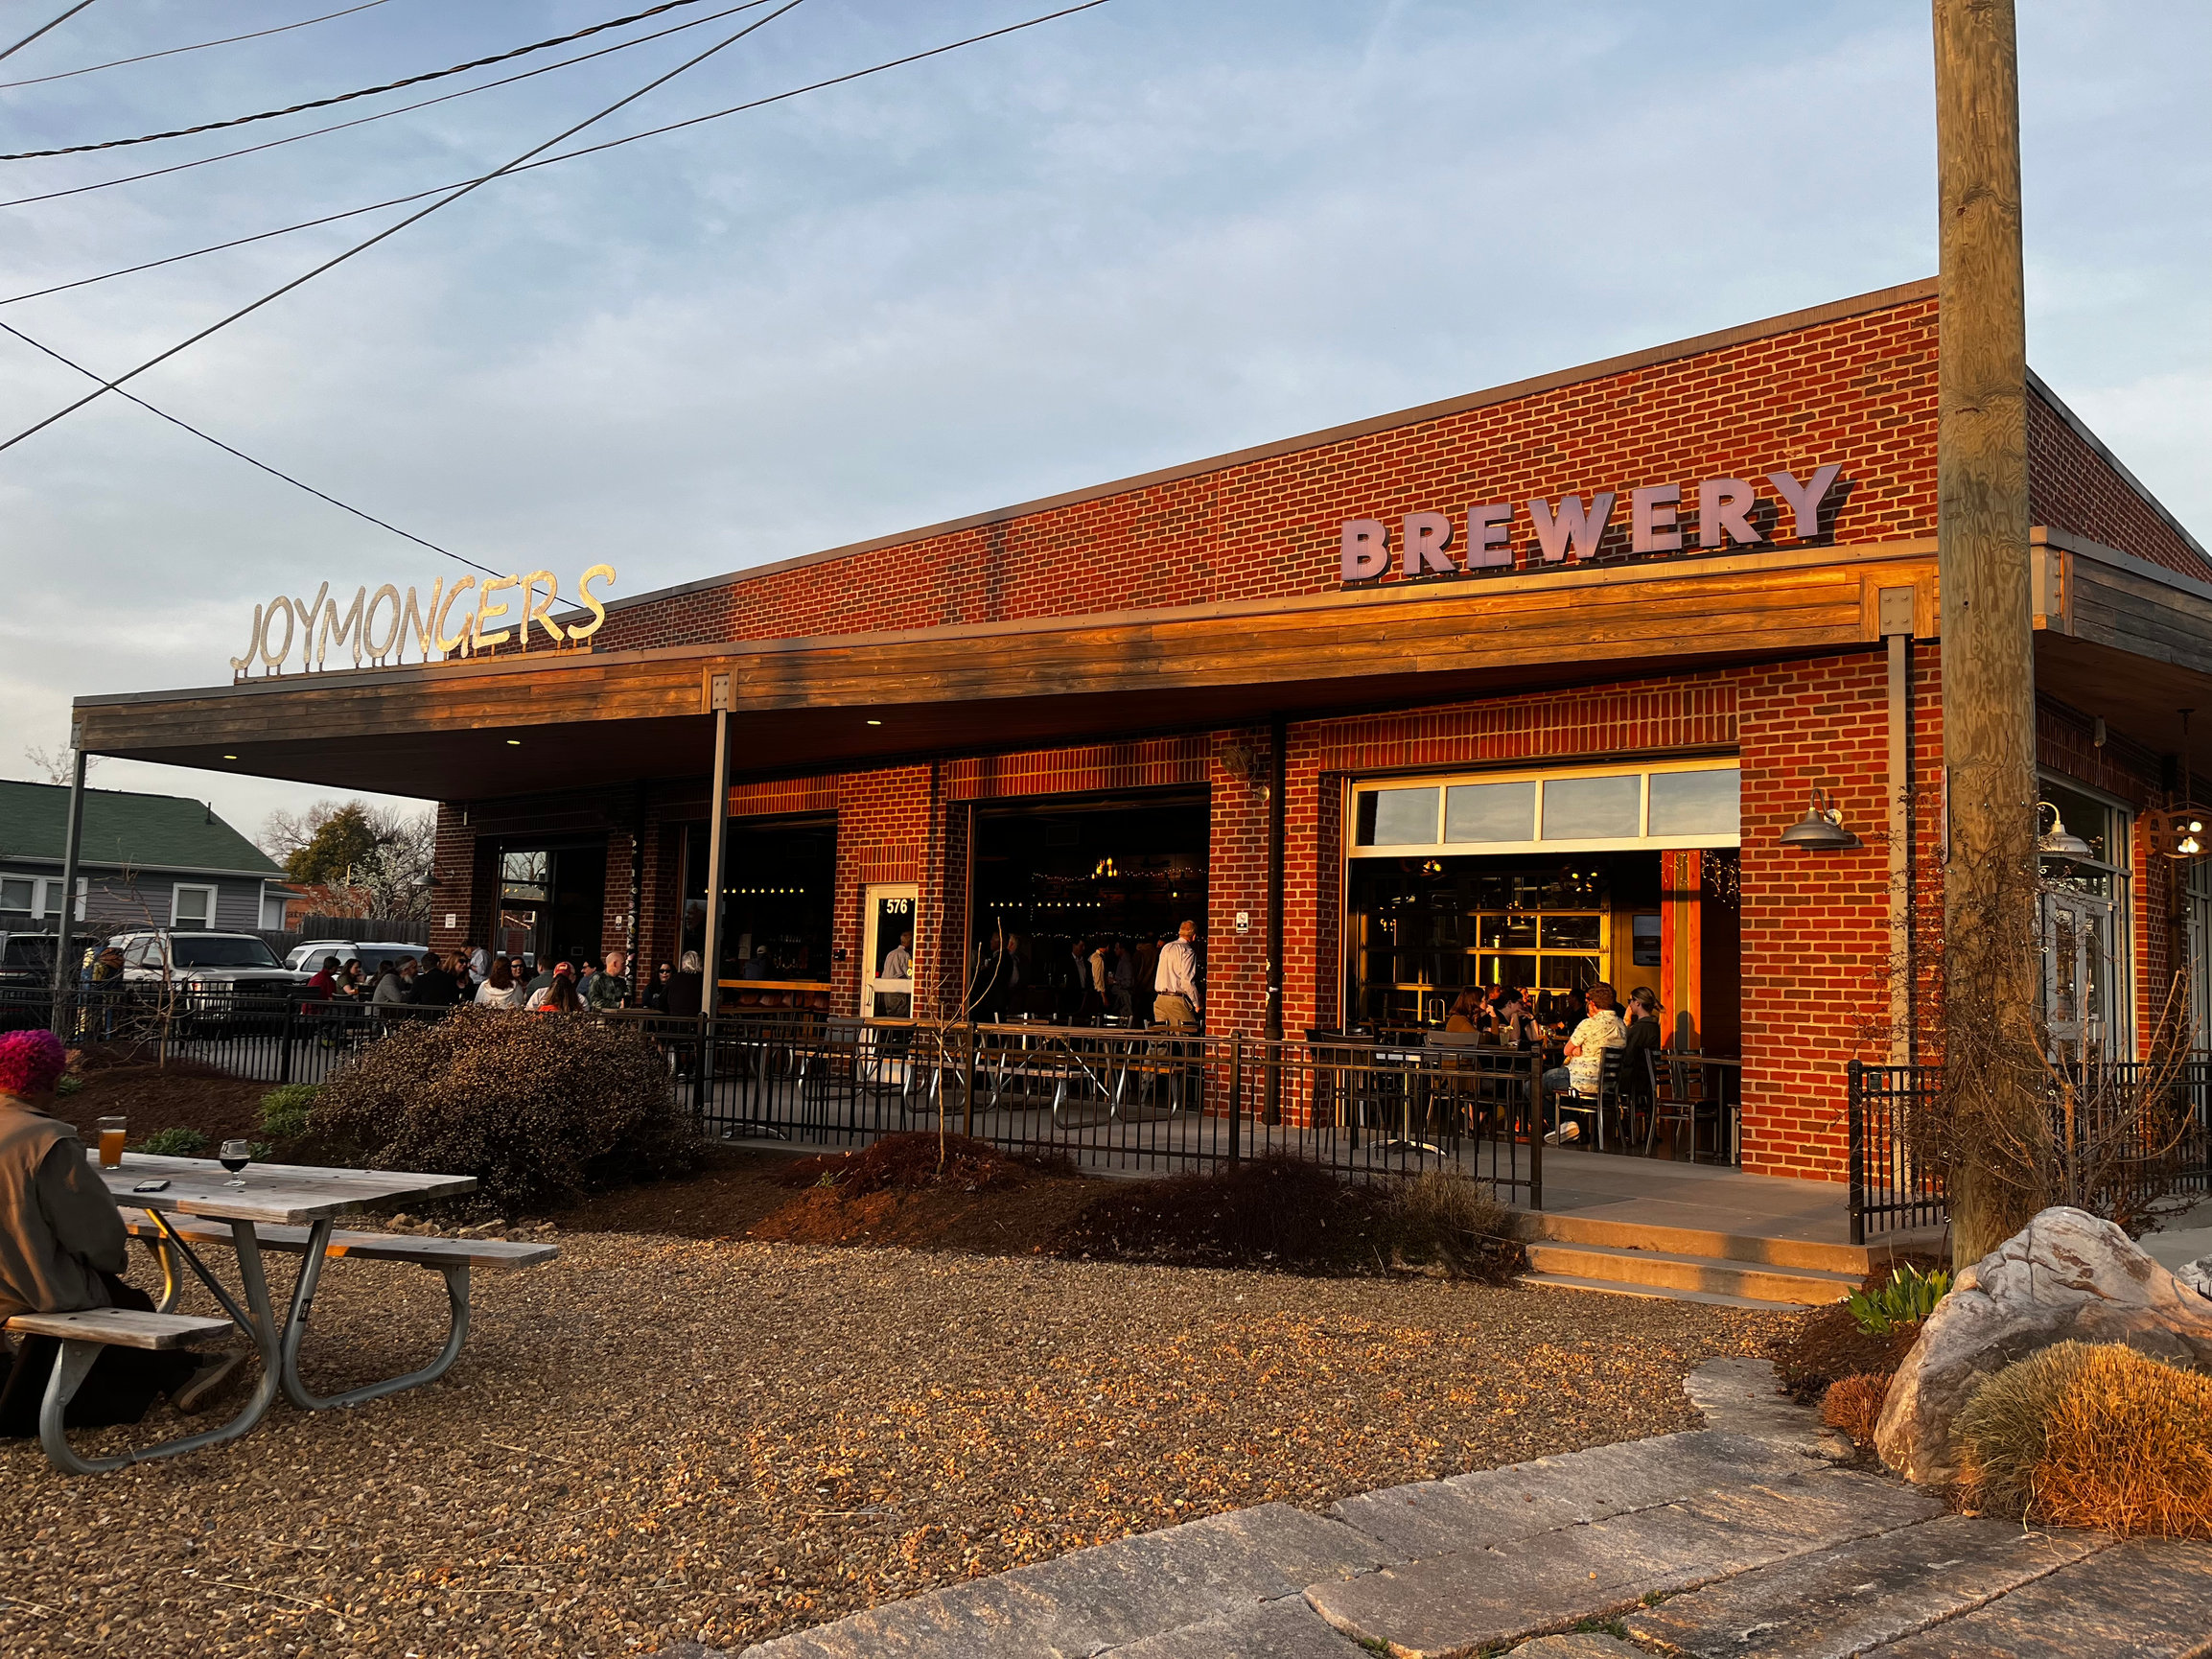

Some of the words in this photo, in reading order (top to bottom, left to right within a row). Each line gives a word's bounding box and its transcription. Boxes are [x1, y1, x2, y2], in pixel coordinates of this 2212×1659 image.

[1341, 463, 1842, 581] BREWERY
[230, 564, 617, 670] JOYMONGERS
[886, 899, 908, 914] 576
